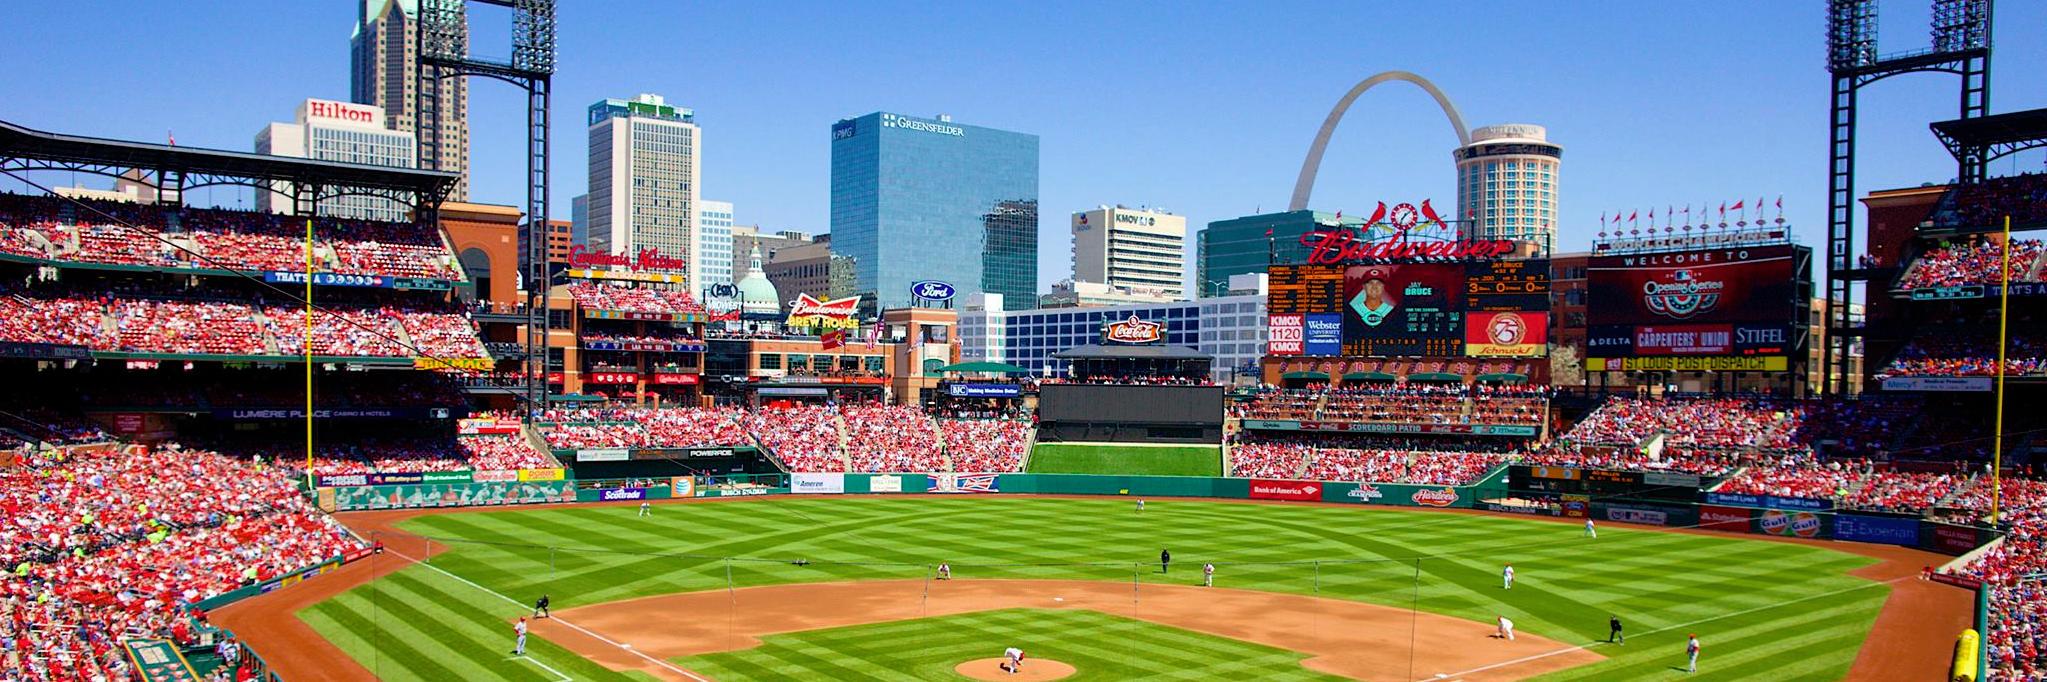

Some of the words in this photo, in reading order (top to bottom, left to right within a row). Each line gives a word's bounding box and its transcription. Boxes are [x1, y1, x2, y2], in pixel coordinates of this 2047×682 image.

[311, 101, 373, 123] Hilton
[897, 116, 964, 137] GREENSFELDER
[832, 127, 853, 140] KPMG
[1115, 213, 1138, 225] KMOV
[1299, 229, 1514, 264] Budweiser
[1610, 237, 1666, 250] WORLD
[1667, 231, 1771, 248] CHAMPIONS
[567, 244, 631, 269] Cardinals
[631, 246, 684, 271] Nation
[1625, 252, 1712, 267] WELCOME
[1726, 250, 1749, 260] TO
[313, 274, 321, 283] A
[716, 284, 732, 296] FOX
[921, 283, 948, 297] Ford
[1404, 287, 1433, 296] BRUCE
[1469, 282, 1478, 292] 3
[1496, 282, 1505, 292] 0
[1525, 282, 1535, 292] 0
[1644, 280, 1688, 295] Opening
[1688, 279, 1723, 293] Series
[788, 299, 859, 316] Budweiser
[787, 315, 821, 327] BREW
[822, 316, 860, 329] HOUSE
[1270, 315, 1301, 326] KMOX
[1307, 320, 1341, 330] Webster
[1115, 324, 1154, 338] Coca-Cola
[1271, 328, 1301, 340] 1120
[1494, 319, 1519, 344] 75
[1736, 327, 1787, 344] STIFEL
[1598, 337, 1631, 346] DELTA
[1637, 332, 1699, 347] CARPENTERS'
[1701, 331, 1729, 347] UNION
[1270, 342, 1301, 352] KMOX
[1479, 346, 1534, 354] Schnucks
[1354, 361, 1365, 373] 10
[1625, 358, 1639, 370] ST.
[1643, 358, 1674, 369] LOUIS
[1677, 356, 1766, 369] POST-DISPATCH
[951, 385, 966, 394] BJC
[289, 410, 332, 418] PLACE
[1347, 423, 1397, 432] SCOREBOARD
[690, 449, 734, 457] POWERADE
[604, 488, 641, 500] Scottrade
[742, 488, 767, 496] STADIUM
[1253, 486, 1269, 494] Bank
[1269, 486, 1277, 494] of
[1277, 487, 1302, 495] America
[1719, 494, 1739, 502] Merrill
[1740, 496, 1757, 504] Lynch
[1801, 499, 1820, 507] Lynch
[1488, 503, 1509, 512] BUSCH
[1510, 505, 1536, 514] STADIUM
[1762, 517, 1788, 527] Gulf
[1791, 519, 1817, 530] Gulf
[1857, 522, 1915, 539] Experian
